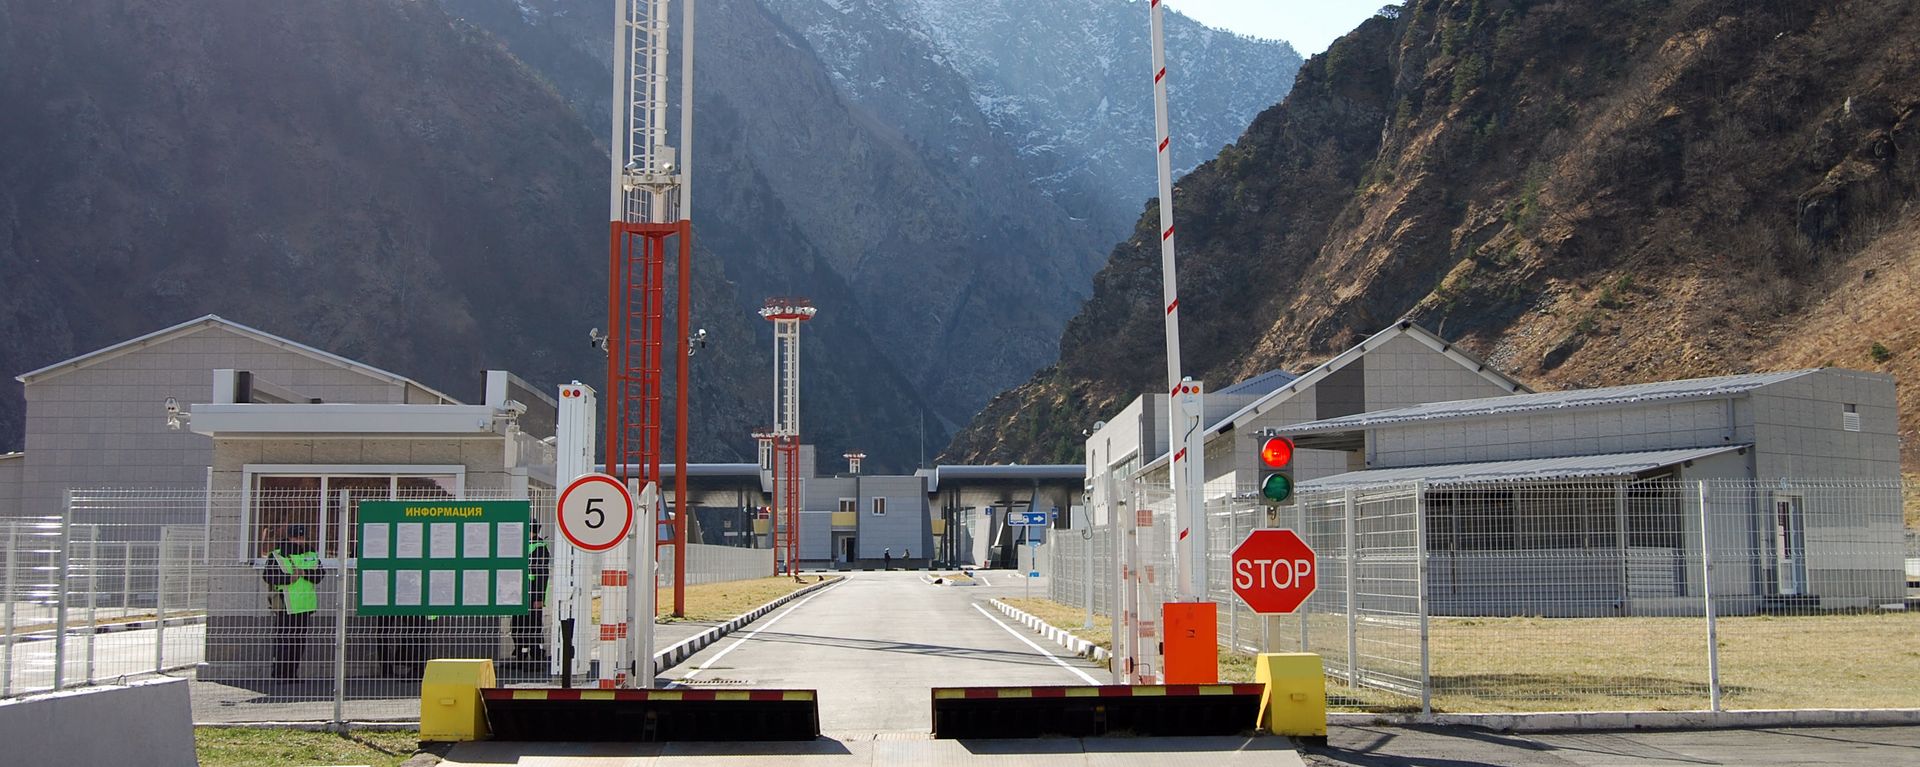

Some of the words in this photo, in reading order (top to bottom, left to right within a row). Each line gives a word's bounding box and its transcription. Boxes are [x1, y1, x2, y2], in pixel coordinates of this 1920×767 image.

[405, 507, 482, 518] ИНФОРМАЦИЯ
[585, 498, 605, 529] 5
[1235, 558, 1311, 589] STOP
